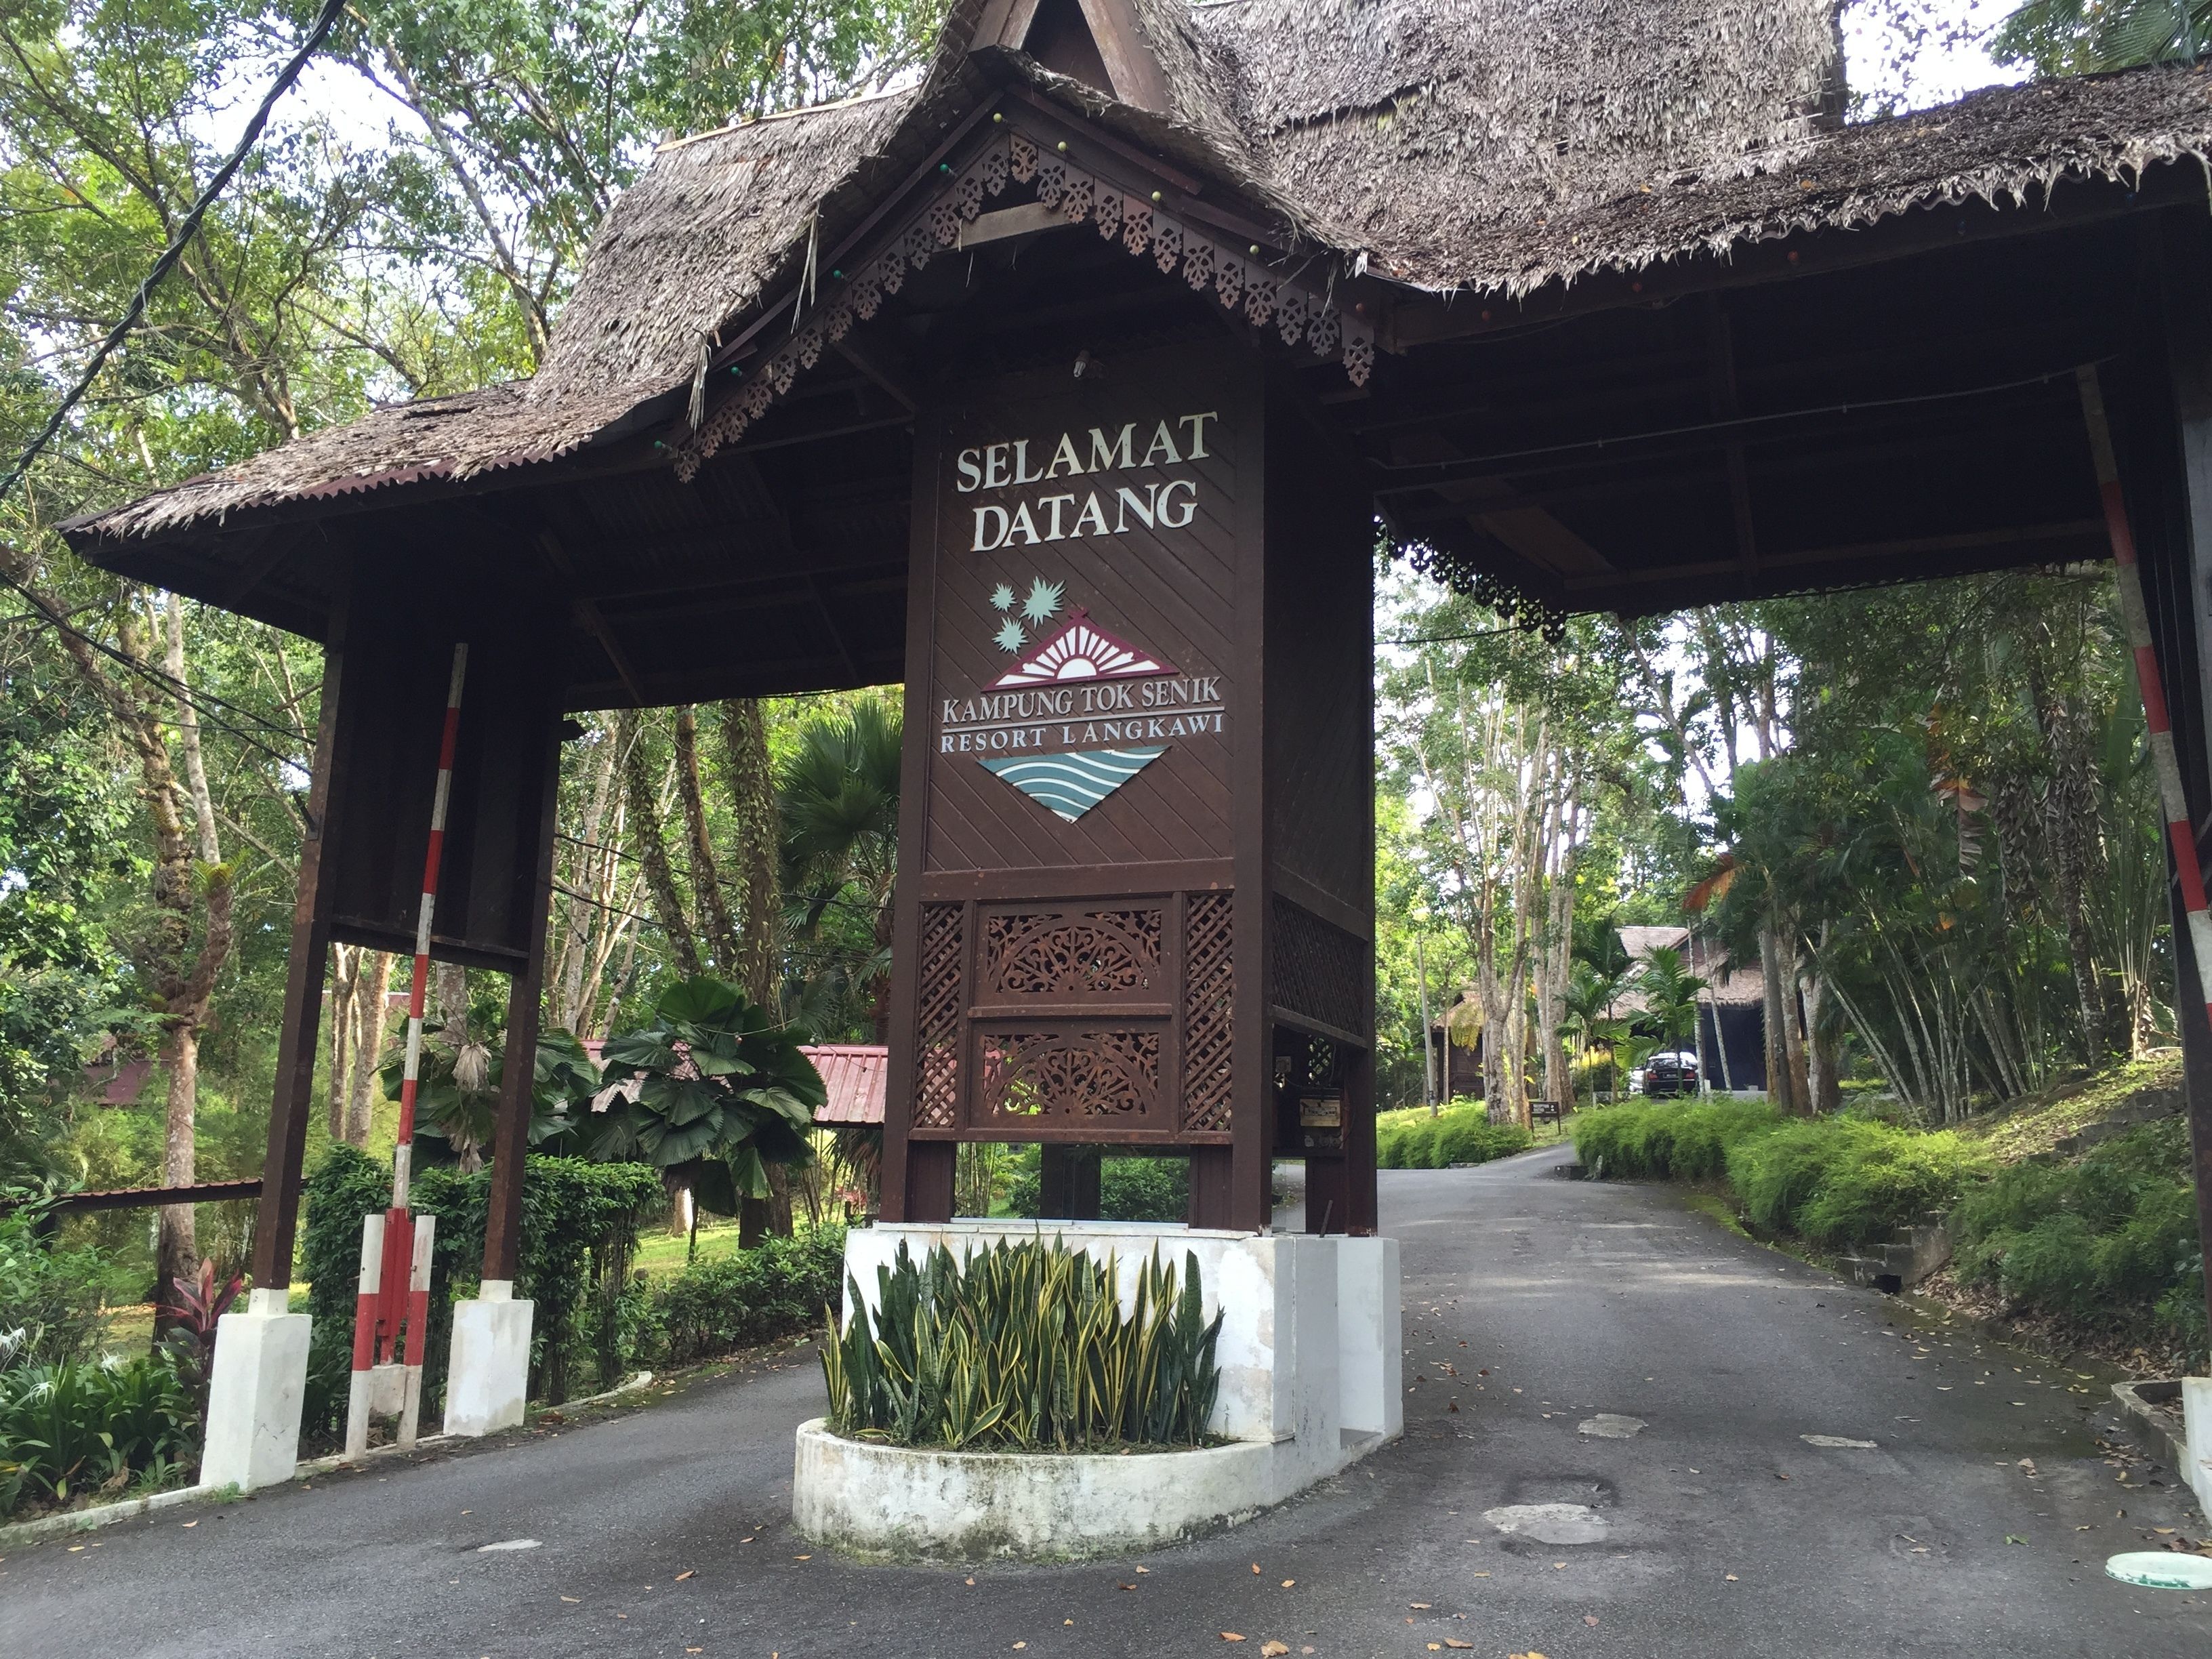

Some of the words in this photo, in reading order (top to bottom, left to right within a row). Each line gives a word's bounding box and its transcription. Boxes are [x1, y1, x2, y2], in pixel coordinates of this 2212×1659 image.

[957, 411, 1218, 493] SELAMAT
[970, 480, 1198, 552] DATANG
[942, 689, 1073, 723] KAMPUNG
[1081, 684, 1134, 712] TOK
[1141, 676, 1222, 708] SENIK
[940, 727, 1046, 754] RESORT
[1062, 714, 1223, 744] LANGKAWI
